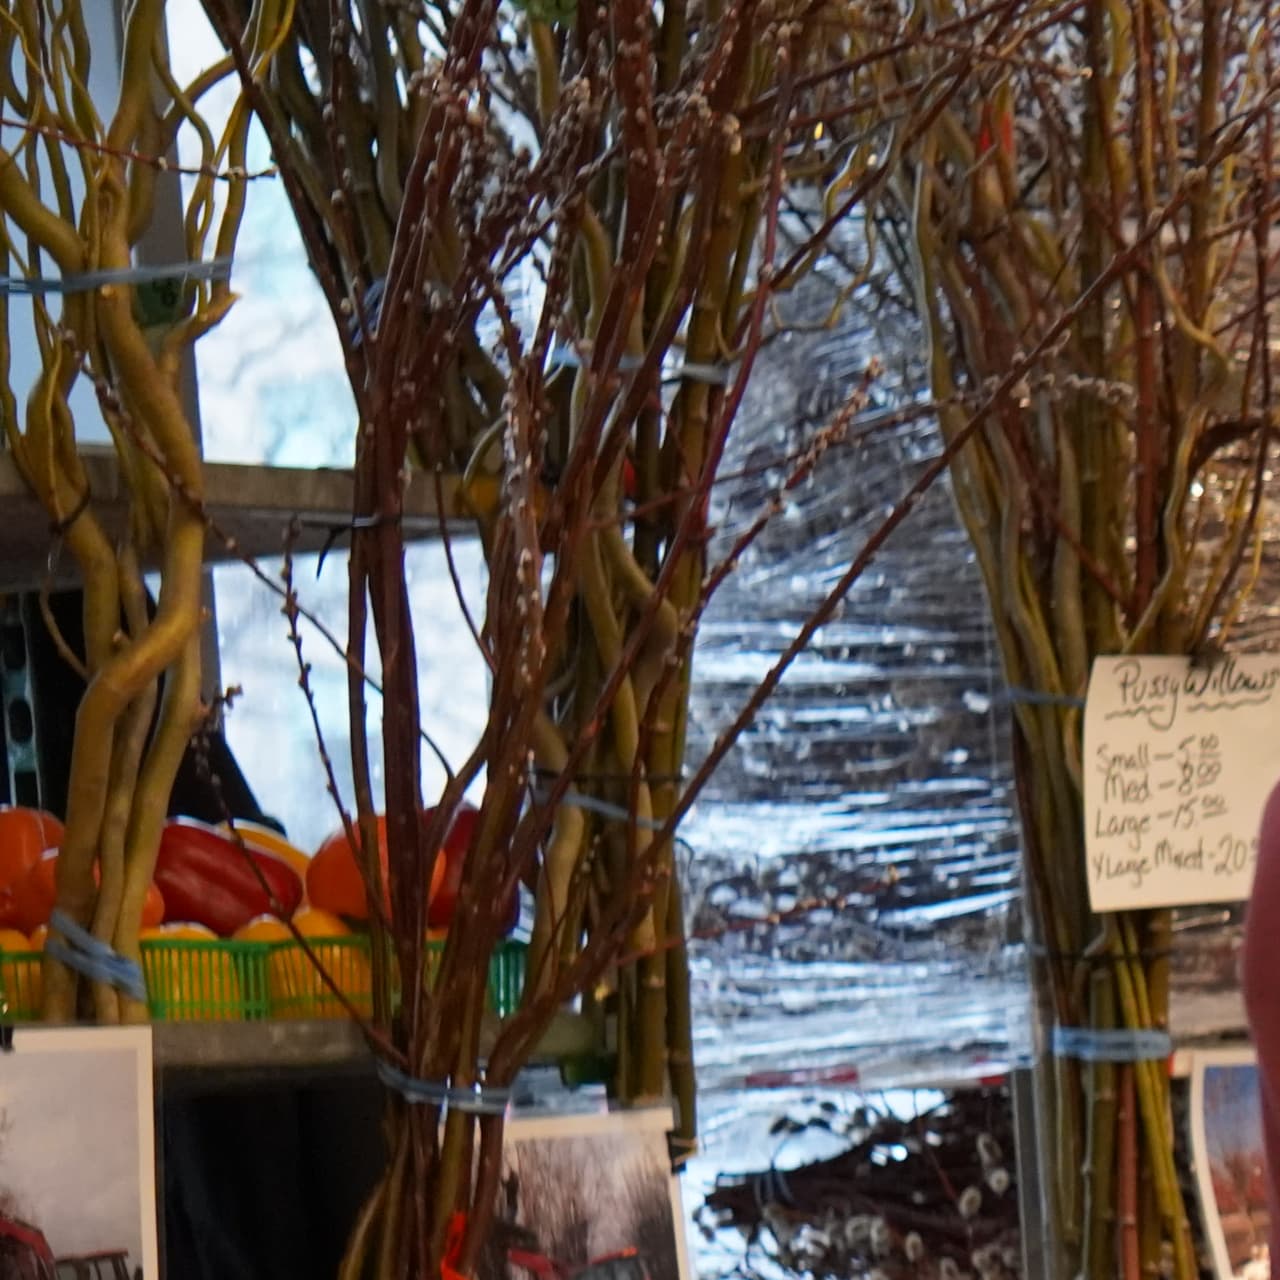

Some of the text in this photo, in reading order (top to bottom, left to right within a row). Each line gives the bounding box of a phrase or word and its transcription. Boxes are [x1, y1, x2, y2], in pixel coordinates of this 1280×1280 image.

[1113, 659, 1280, 731] Pussy Willows
[1097, 742, 1150, 775] Small
[1095, 807, 1152, 851] Large
